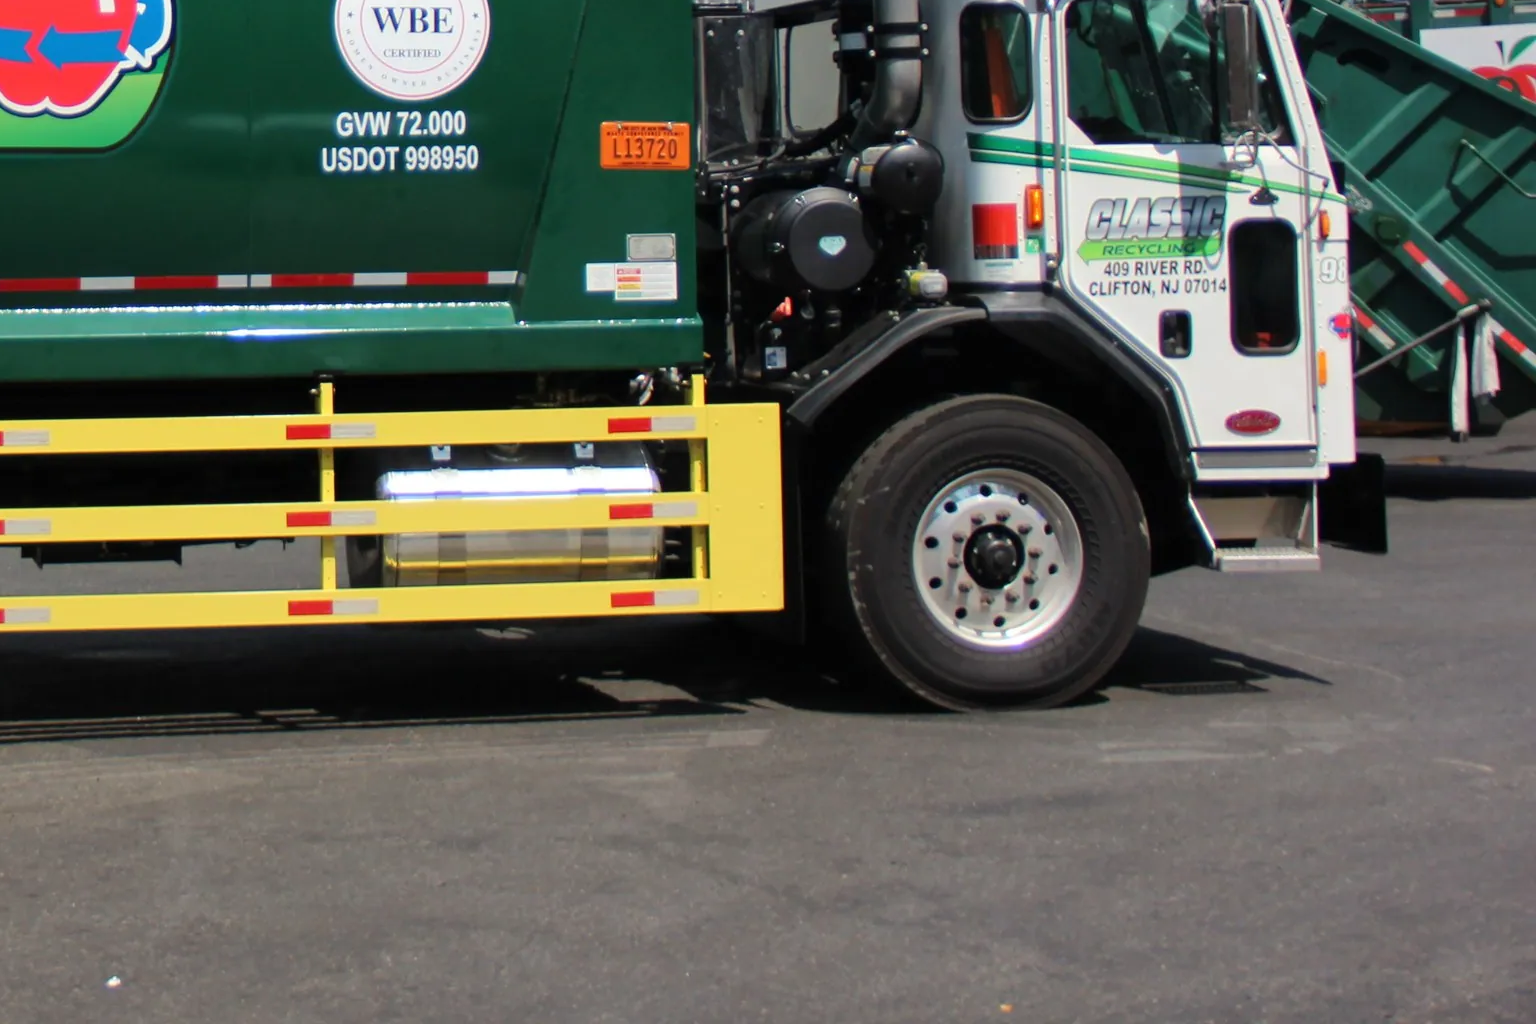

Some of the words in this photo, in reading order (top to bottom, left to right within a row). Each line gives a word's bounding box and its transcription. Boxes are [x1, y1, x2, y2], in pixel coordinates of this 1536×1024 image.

[370, 6, 454, 34] WBE
[383, 48, 442, 58] CERTIFIED
[335, 111, 392, 137] GVW
[396, 110, 467, 136] 72.000
[321, 146, 400, 172] USDOT
[405, 144, 480, 171] 998950
[612, 137, 678, 160] L13720
[1085, 196, 1227, 241] CLASSIC
[1101, 242, 1196, 256] RECYCLING
[1103, 261, 1130, 276] 409
[1134, 259, 1179, 275] RIVER
[1183, 259, 1208, 274] RD.
[1089, 281, 1156, 297] CLIFTON,
[1160, 279, 1180, 294] NJ
[1184, 278, 1227, 293] 07014
